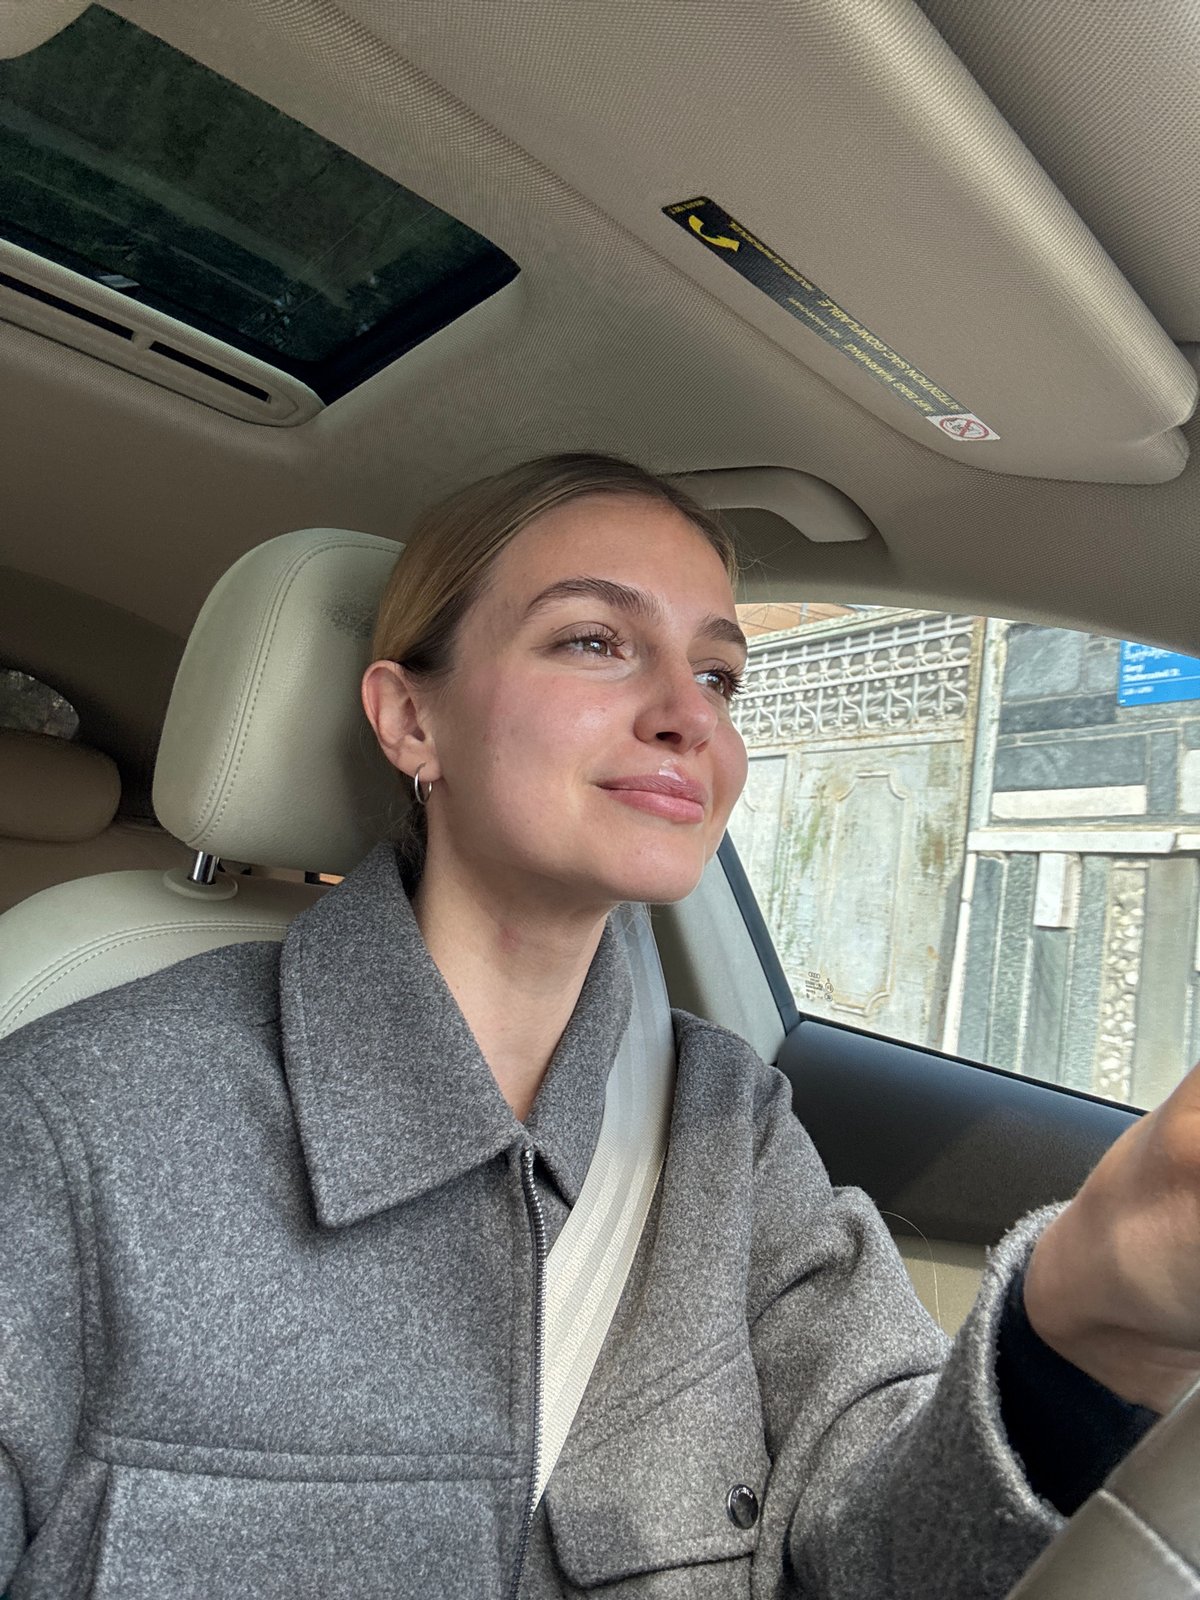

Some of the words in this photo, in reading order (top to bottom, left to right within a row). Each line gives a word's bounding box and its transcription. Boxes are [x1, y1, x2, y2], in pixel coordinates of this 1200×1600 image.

[817, 298, 888, 352] GONFLABLE
[843, 342, 897, 383] WARNING
[882, 351, 911, 370] SAC
[904, 368, 961, 411] ATTENTION
